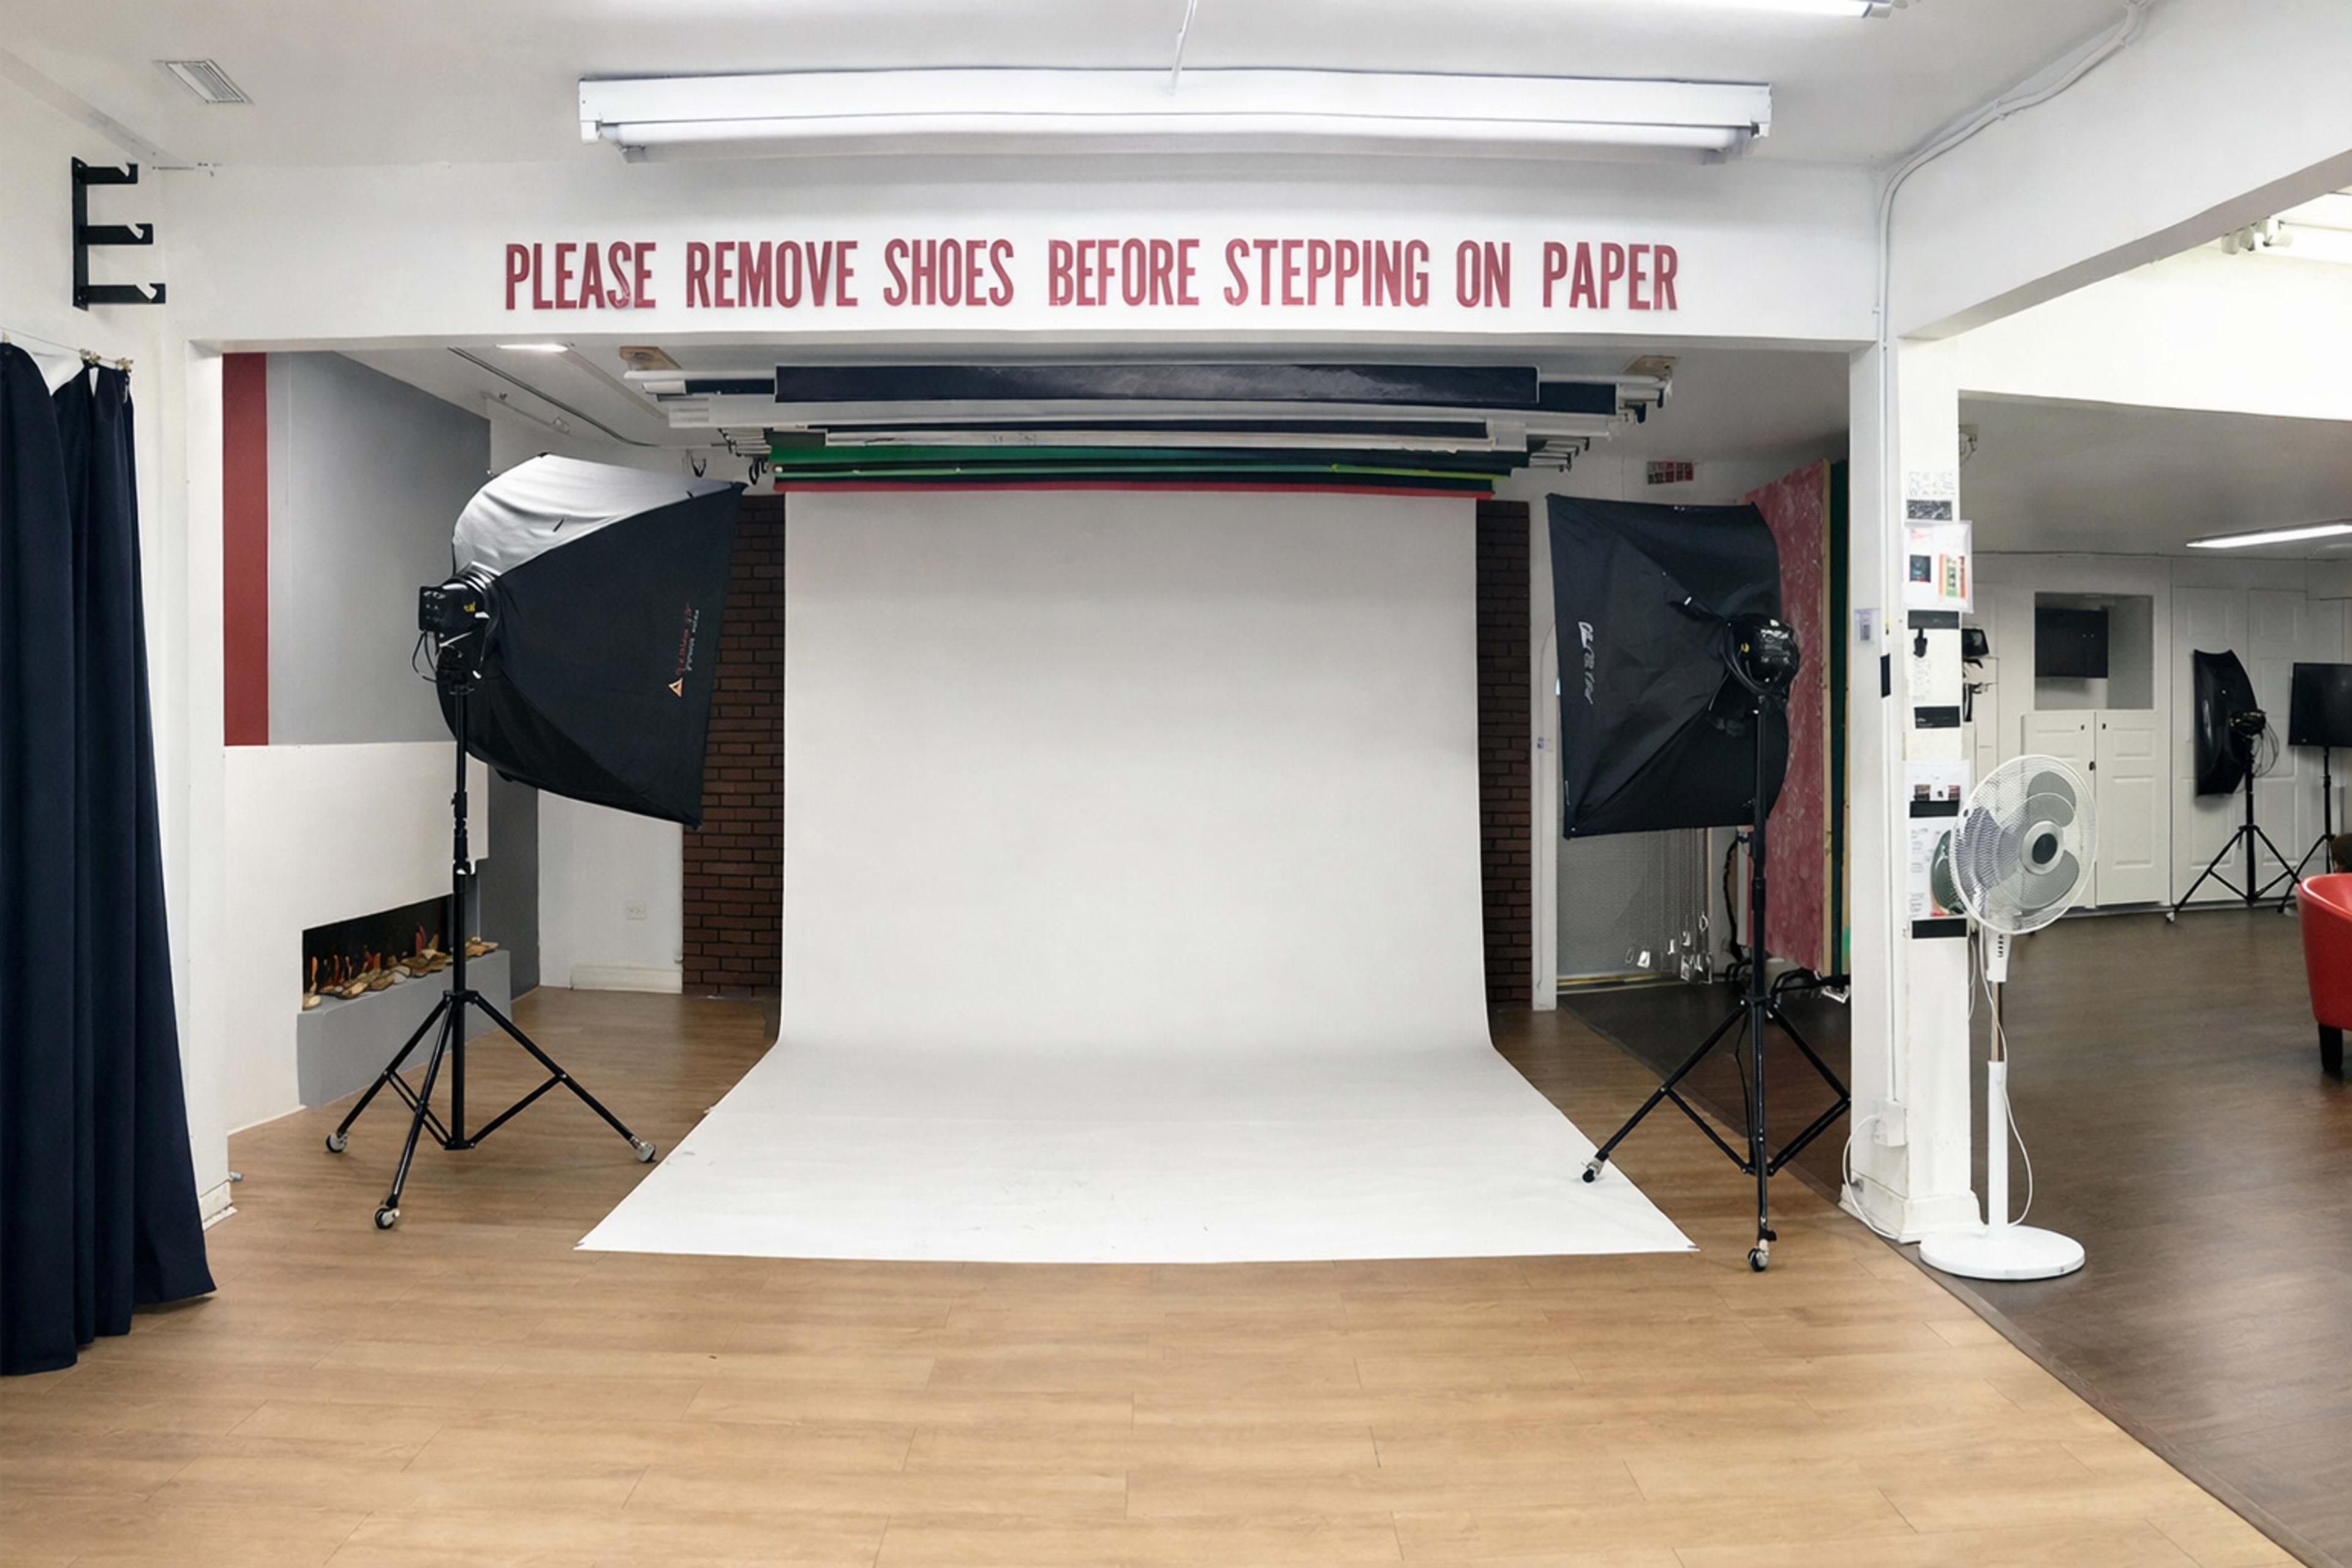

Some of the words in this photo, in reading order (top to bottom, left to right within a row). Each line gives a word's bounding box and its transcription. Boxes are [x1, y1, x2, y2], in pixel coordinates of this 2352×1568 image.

[507, 243, 656, 310] PLEASE
[687, 241, 858, 307] REMOVE
[884, 239, 1014, 306] SHOES
[1049, 238, 1199, 306] BEFORE
[1224, 239, 1428, 307] STEPPING
[1456, 241, 1510, 307] ON
[1543, 242, 1678, 310] PAPER
